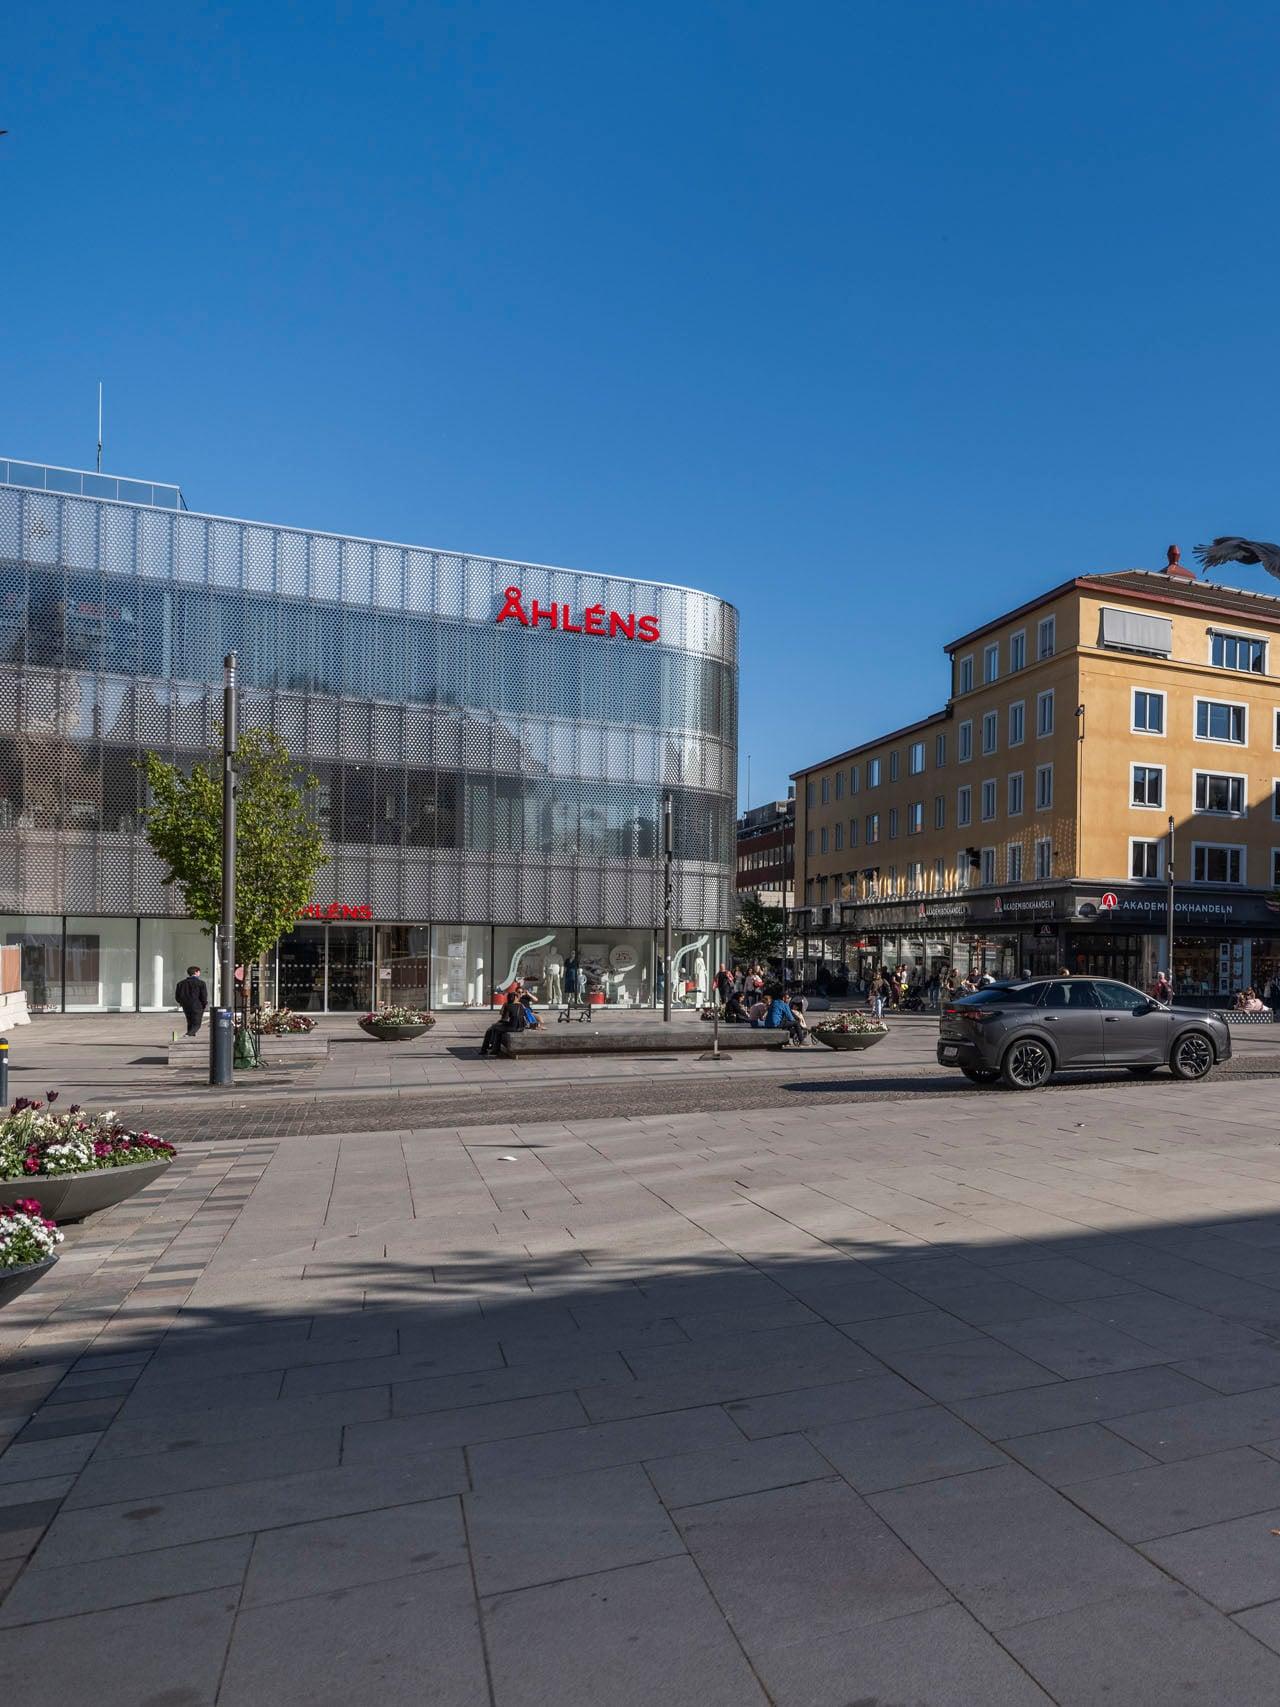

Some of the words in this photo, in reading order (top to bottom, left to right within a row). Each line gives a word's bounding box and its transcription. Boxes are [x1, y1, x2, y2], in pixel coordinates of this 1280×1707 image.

[496, 586, 660, 642] ÅHLÉNS
[296, 902, 372, 919] HLÉNS
[1003, 900, 1055, 911] AKADEMIBOKHANDELN
[1123, 901, 1232, 913] AKADEMIOKHANDELN
